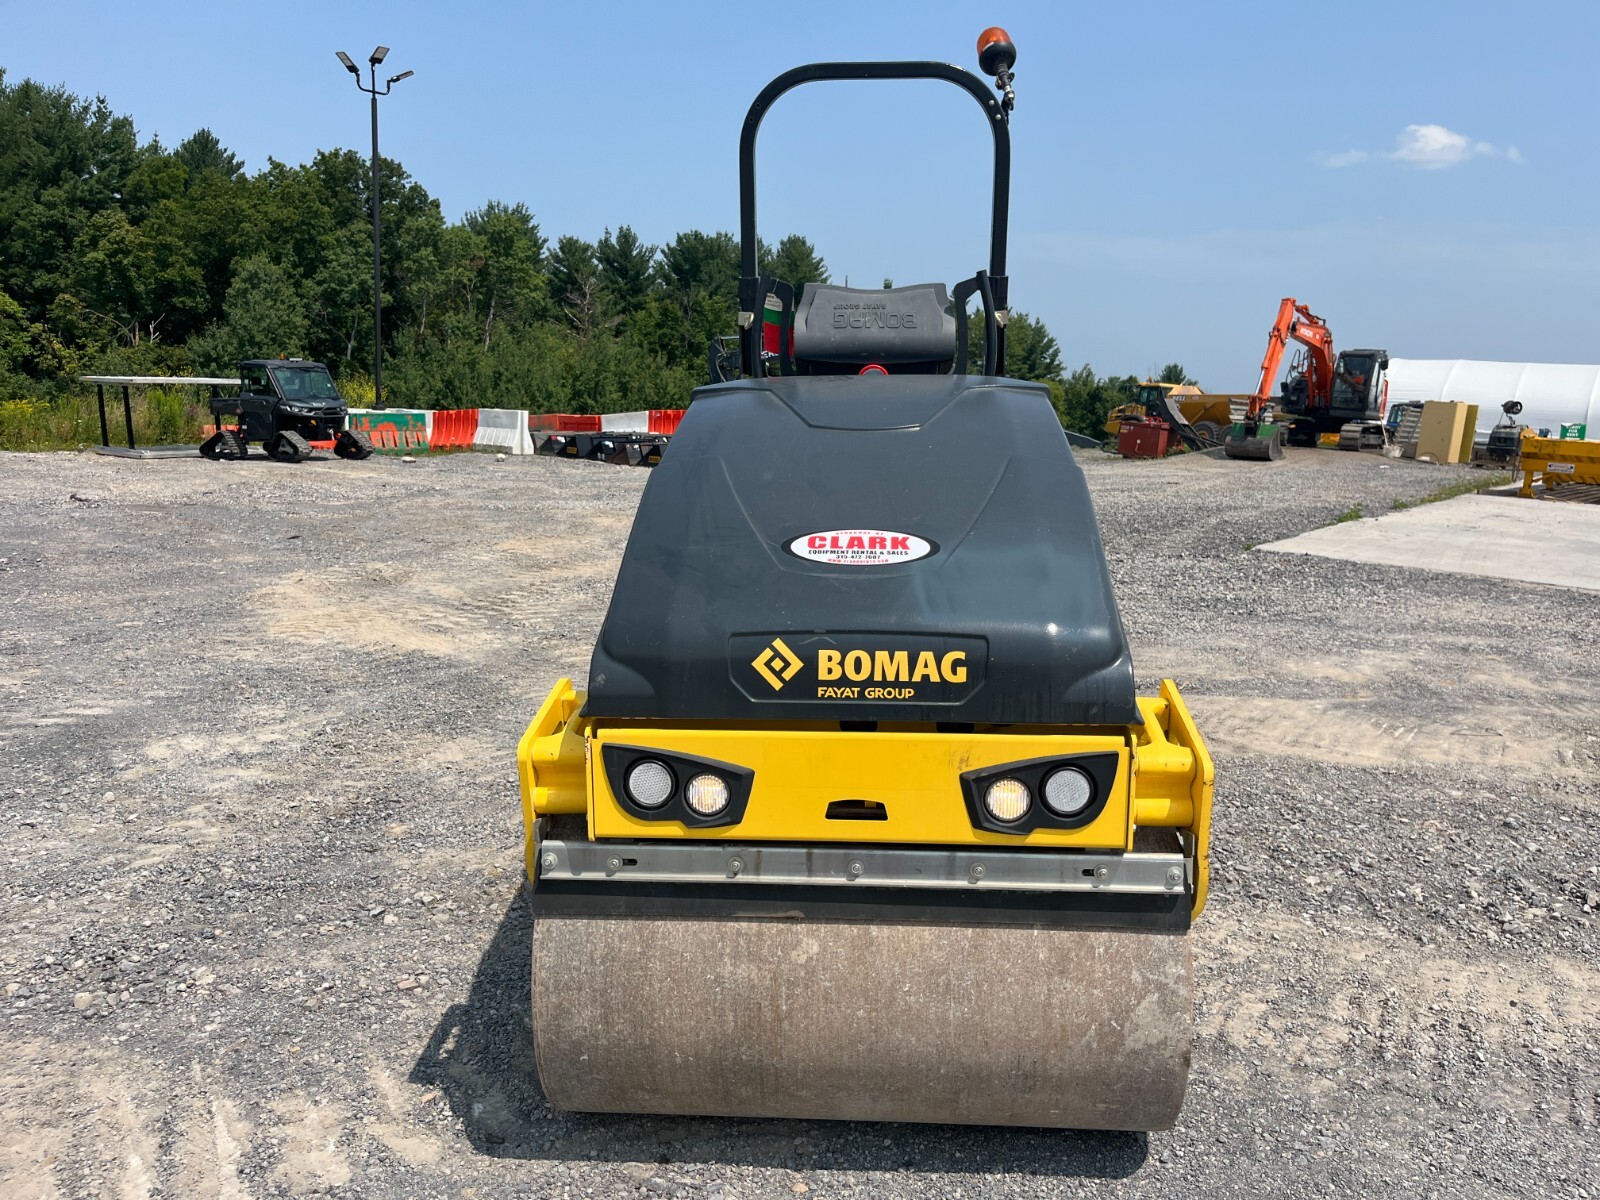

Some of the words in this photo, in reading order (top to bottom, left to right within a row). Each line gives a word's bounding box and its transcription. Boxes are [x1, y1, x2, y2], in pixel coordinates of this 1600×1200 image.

[833, 311, 917, 329] BOMAG
[807, 535, 911, 550] CLARK
[817, 649, 967, 683] BOMAG
[817, 687, 860, 698] FAYAT
[865, 687, 915, 699] GROUP
